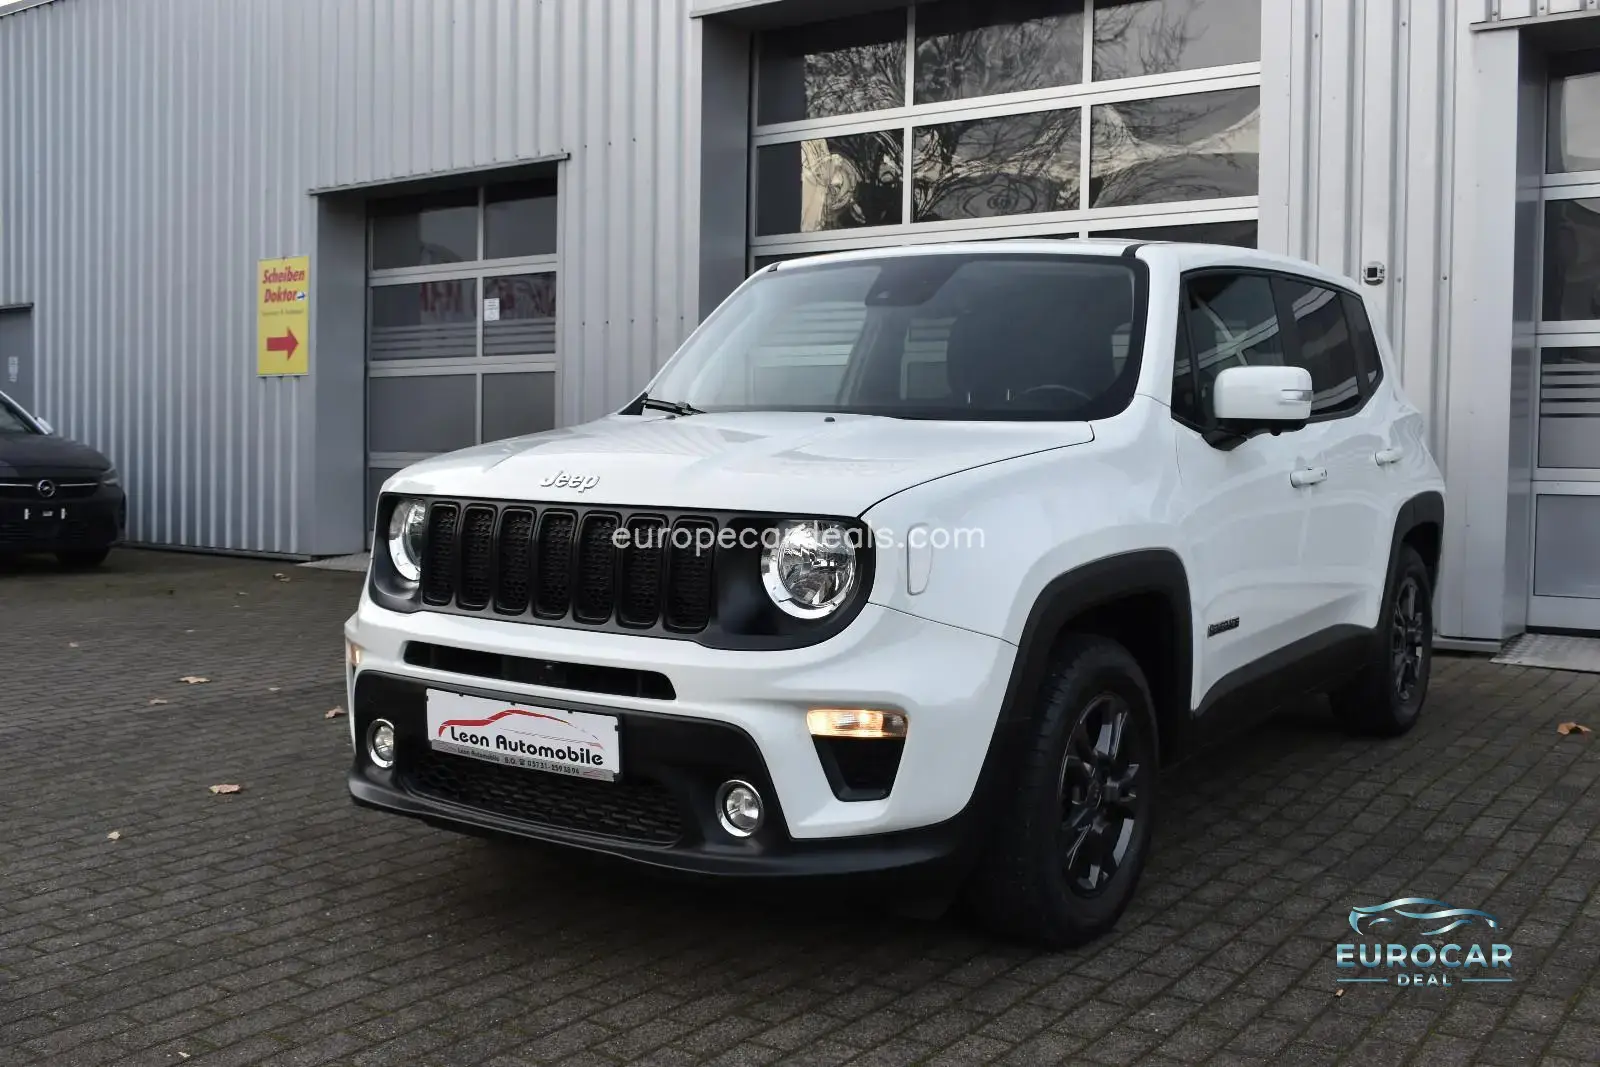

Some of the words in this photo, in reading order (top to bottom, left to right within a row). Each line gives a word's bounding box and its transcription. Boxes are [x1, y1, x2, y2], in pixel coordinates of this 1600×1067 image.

[262, 265, 305, 284] Scheiben
[264, 286, 298, 303] Doktor
[538, 469, 600, 494] Jeep
[450, 726, 490, 748] Leon
[495, 734, 604, 766] Automobile
